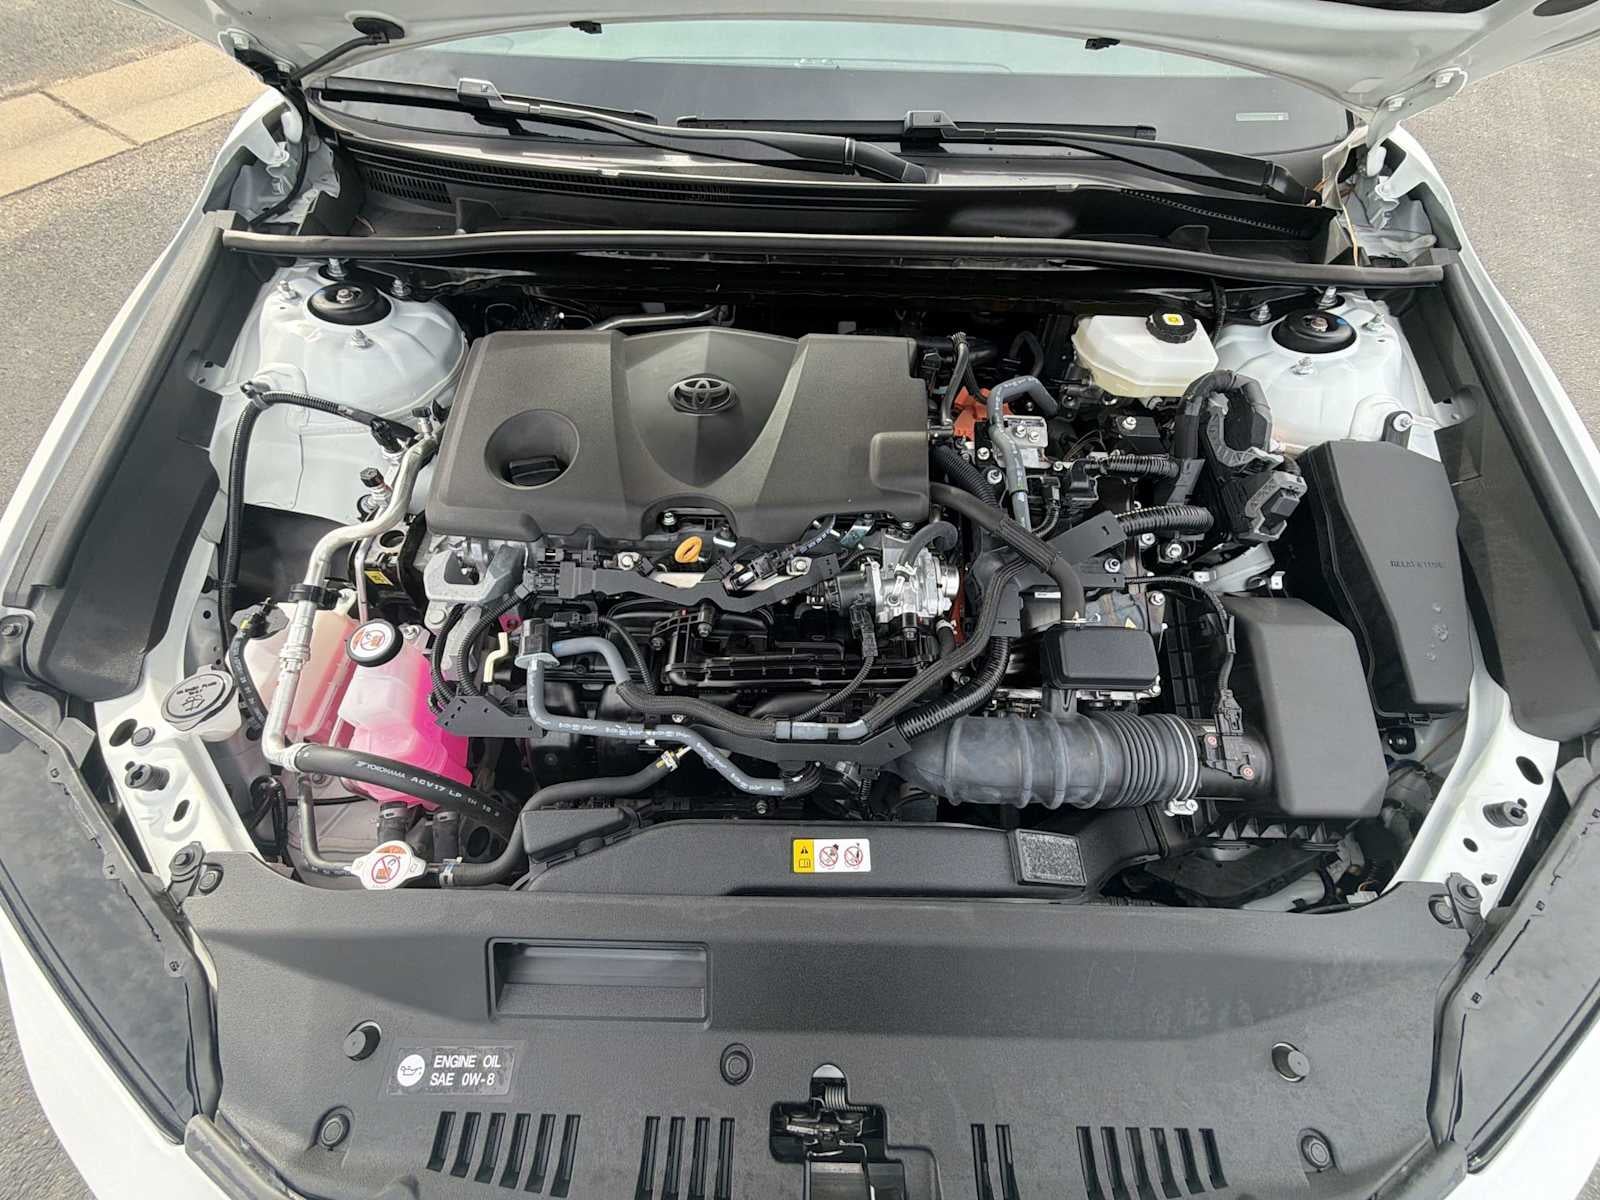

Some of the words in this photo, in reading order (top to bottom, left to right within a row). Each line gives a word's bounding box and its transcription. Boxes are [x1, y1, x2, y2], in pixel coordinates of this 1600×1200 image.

[433, 1055, 477, 1068] ENGINE
[483, 1055, 502, 1068] OIL
[430, 1073, 455, 1086] SAE
[462, 1073, 496, 1086] 0W-8
